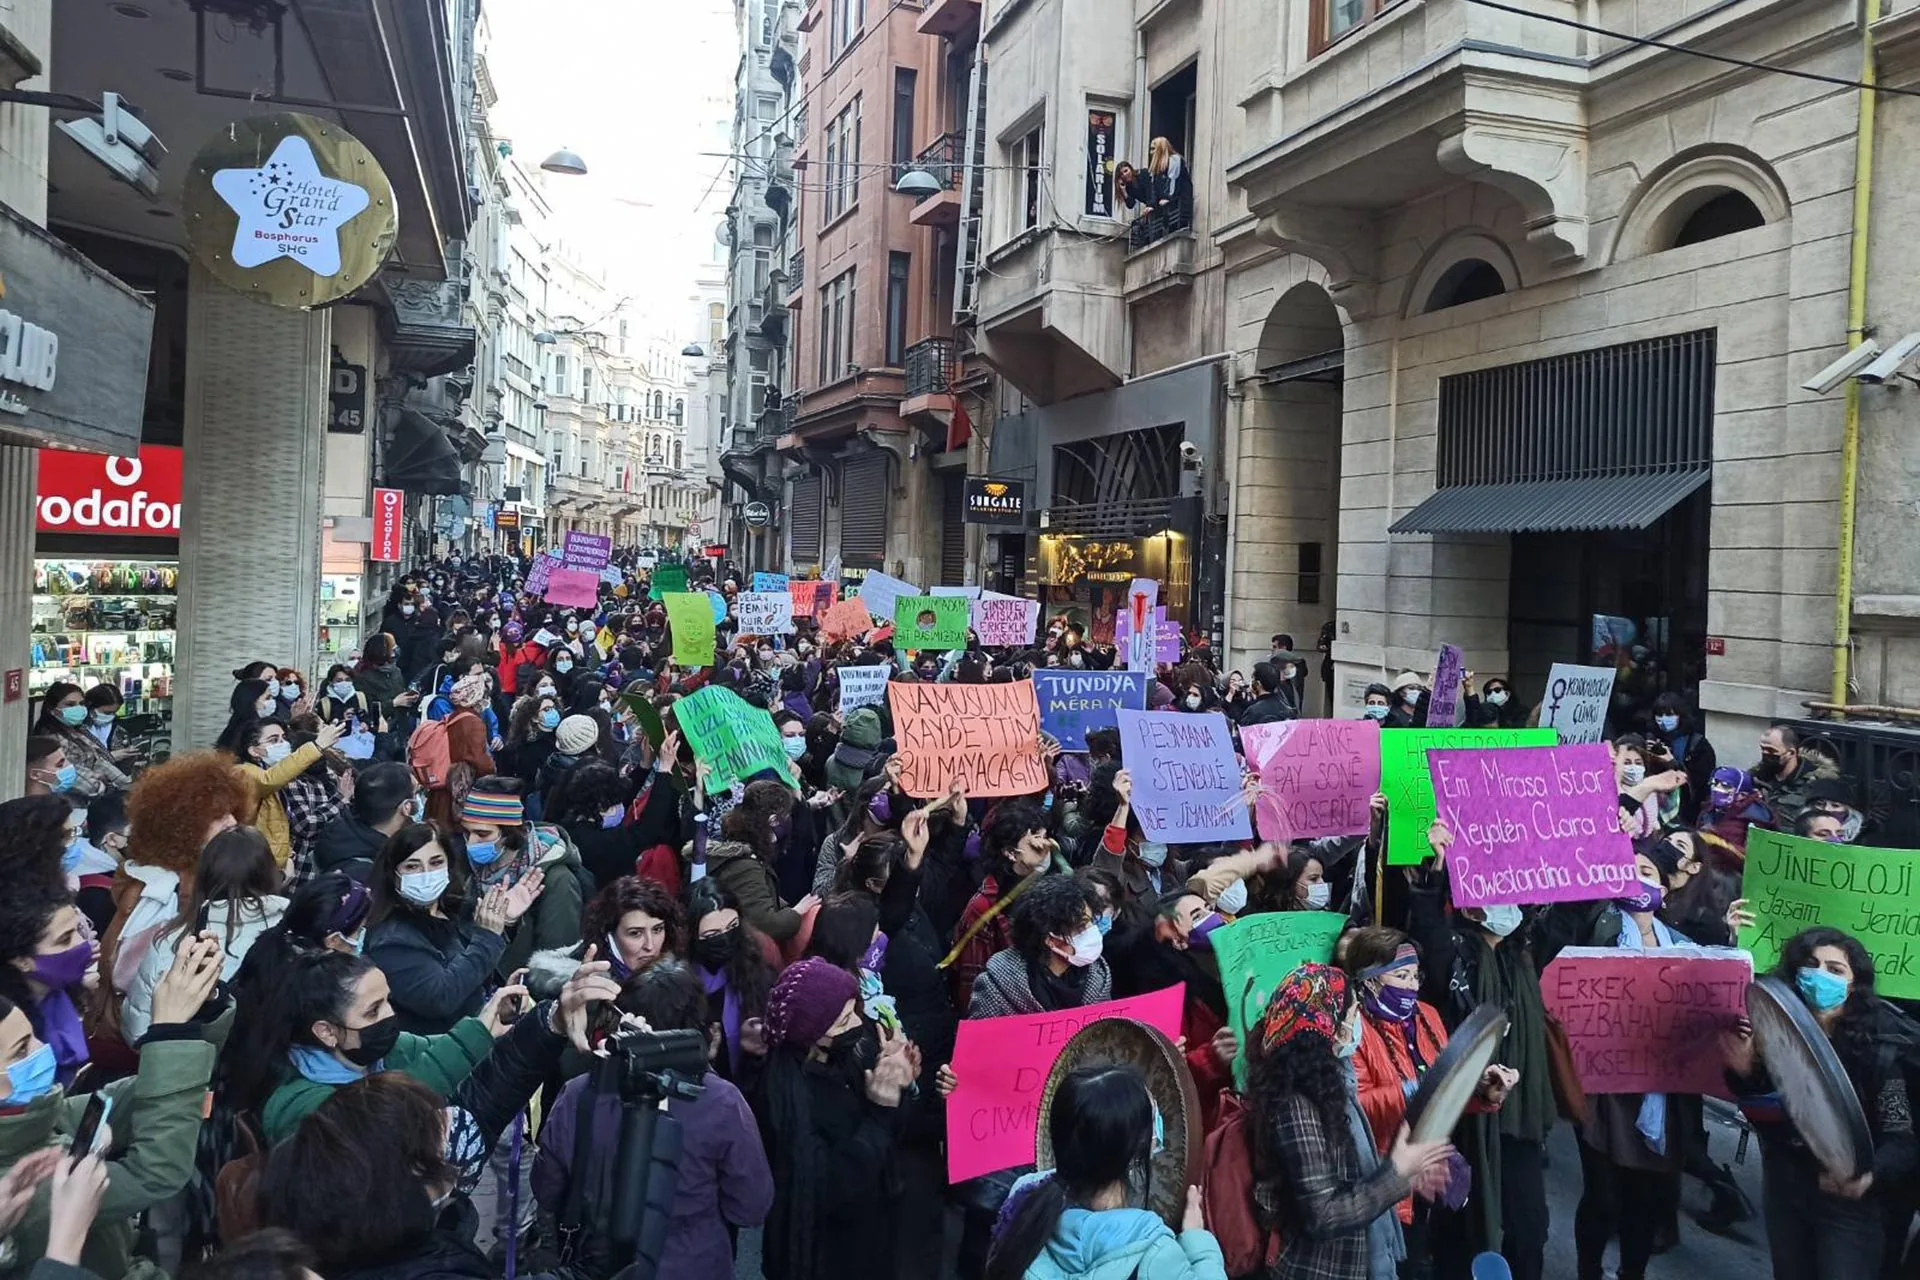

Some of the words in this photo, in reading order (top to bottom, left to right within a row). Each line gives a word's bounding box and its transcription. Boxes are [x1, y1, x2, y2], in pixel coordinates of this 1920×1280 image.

[1093, 133, 1106, 213] SOLARIUM
[263, 187, 345, 217] Grand
[292, 181, 338, 199] Hotel
[278, 207, 329, 229] Star
[254, 230, 319, 244] Bosphorus
[277, 243, 308, 256] SHG
[383, 506, 394, 560] vodafone
[893, 683, 1034, 716] NAMUSUMU
[1273, 764, 1303, 794] PAY
[1438, 760, 1471, 798] Em
[1480, 757, 1549, 798] Mirasa
[1531, 801, 1596, 841] Clara
